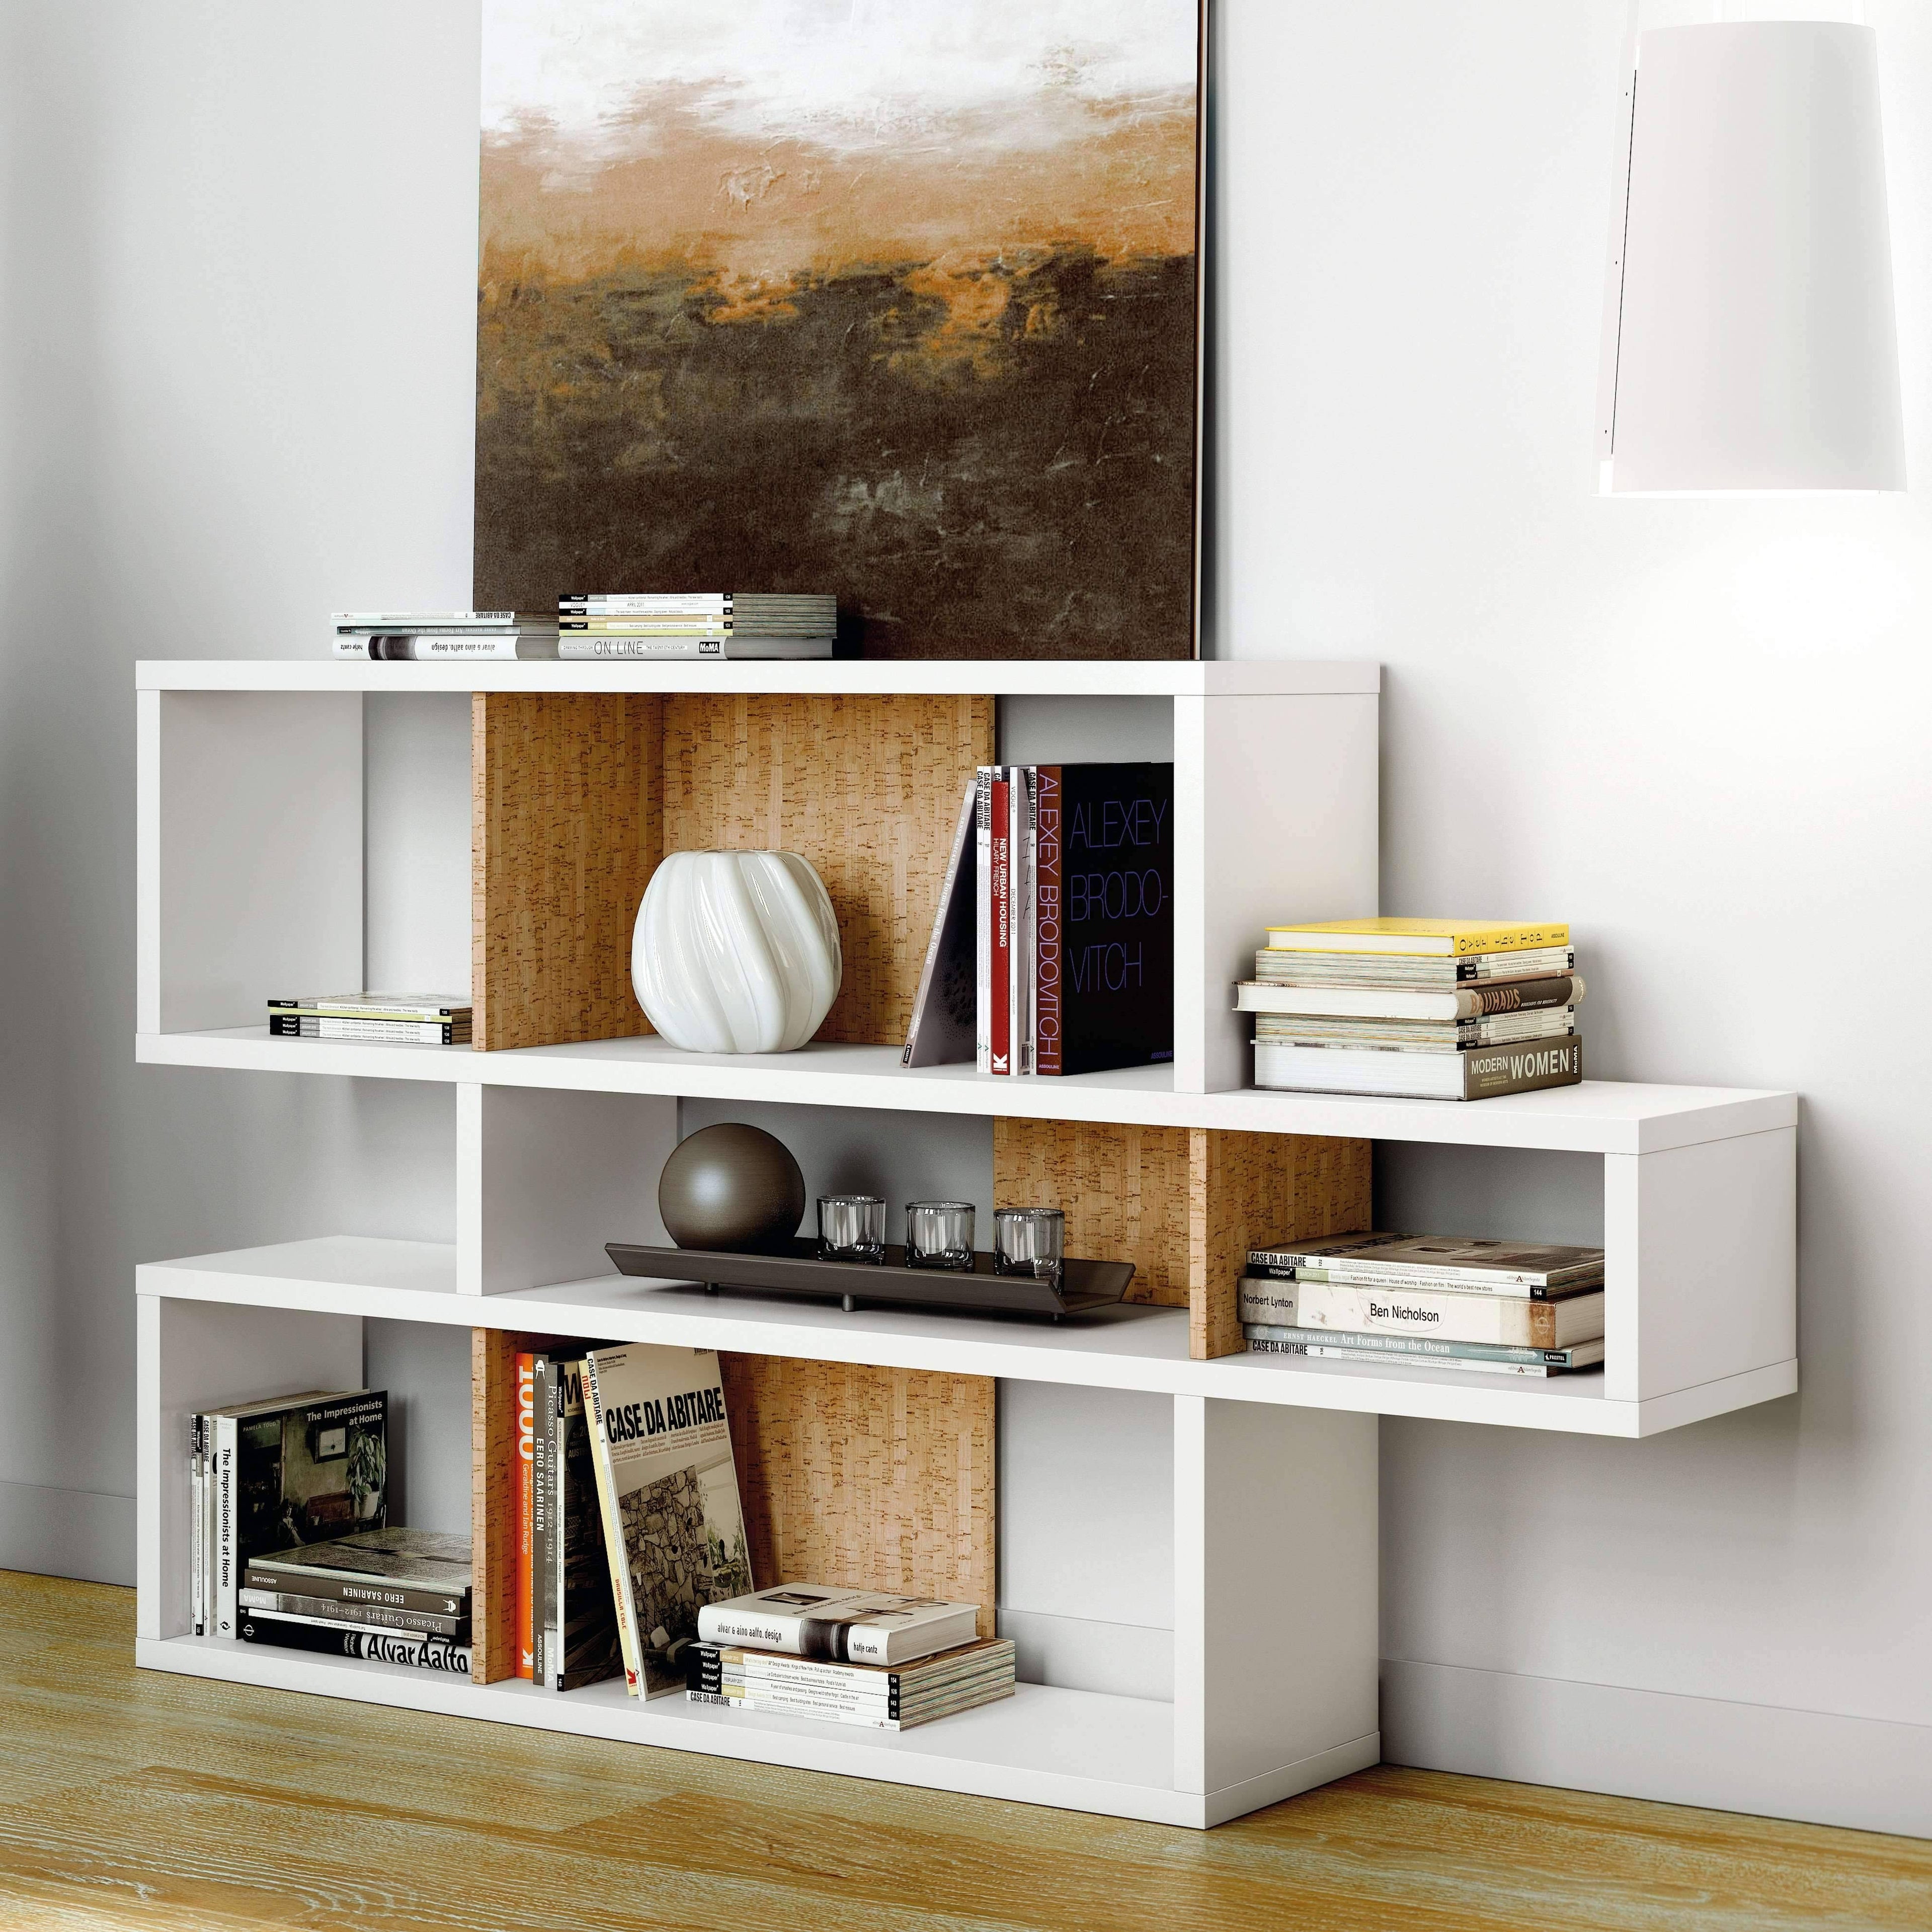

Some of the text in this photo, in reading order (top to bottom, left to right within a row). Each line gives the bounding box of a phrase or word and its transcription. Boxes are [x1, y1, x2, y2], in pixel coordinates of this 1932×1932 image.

[352, 642, 363, 651] hatje
[431, 642, 448, 652] design
[594, 641, 719, 655] ON LINE MoMA
[977, 790, 984, 799] DA
[984, 791, 990, 801] DA
[1029, 791, 1036, 801] DA
[1070, 798, 1167, 850] ALEXEY
[926, 816, 965, 964] ERNST HAECKEL Art Forms from the Ocean
[1071, 868, 1169, 922] BRODO-
[1039, 774, 1059, 1055] ALEXEY BRODOVITCH
[1070, 941, 1142, 993] VITCH
[1471, 988, 1521, 1014] BAUHAUS
[1471, 1048, 1569, 1080] MODERN WOMEN
[1251, 1252, 1307, 1267] CASE DA ABITARE
[1243, 1294, 1439, 1323] Norbert Lynton Ben Nicholson
[1252, 1340, 1308, 1355] CASE DA ABITARE
[1283, 1332, 1450, 1353] ERNST HAECKEL Art Forms from the Ocean
[587, 1358, 603, 1425] CASE DA ABITARE
[306, 1400, 383, 1422] The Impressionists
[349, 1413, 382, 1426] at Home
[547, 1384, 557, 1436] Picasso
[606, 1403, 645, 1444] CASE
[643, 1399, 667, 1435] DA
[667, 1387, 726, 1431] ABITARE
[243, 1424, 262, 1433] PAMELA
[547, 1440, 557, 1496] Guitars
[536, 1437, 544, 1531] EERO SAARINEN
[220, 1448, 231, 1587] The Impressionists at Home
[521, 1531, 529, 1555] Rudge
[251, 1575, 277, 1584] ASSOULINE
[244, 1594, 267, 1604] MoMA
[343, 1586, 404, 1603] EERO SAARINEN
[615, 1579, 624, 1611] DRUSILLA
[366, 1611, 404, 1627] Guitars
[406, 1617, 443, 1633] Picasso
[717, 1622, 731, 1634] alvar
[732, 1627, 736, 1635] &
[737, 1624, 748, 1636] aino
[765, 1628, 782, 1643] design
[367, 1635, 468, 1673] Alvar Aalto
[853, 1642, 878, 1654] hatje cantz
[690, 1692, 730, 1707] CASE DA ABITARE
